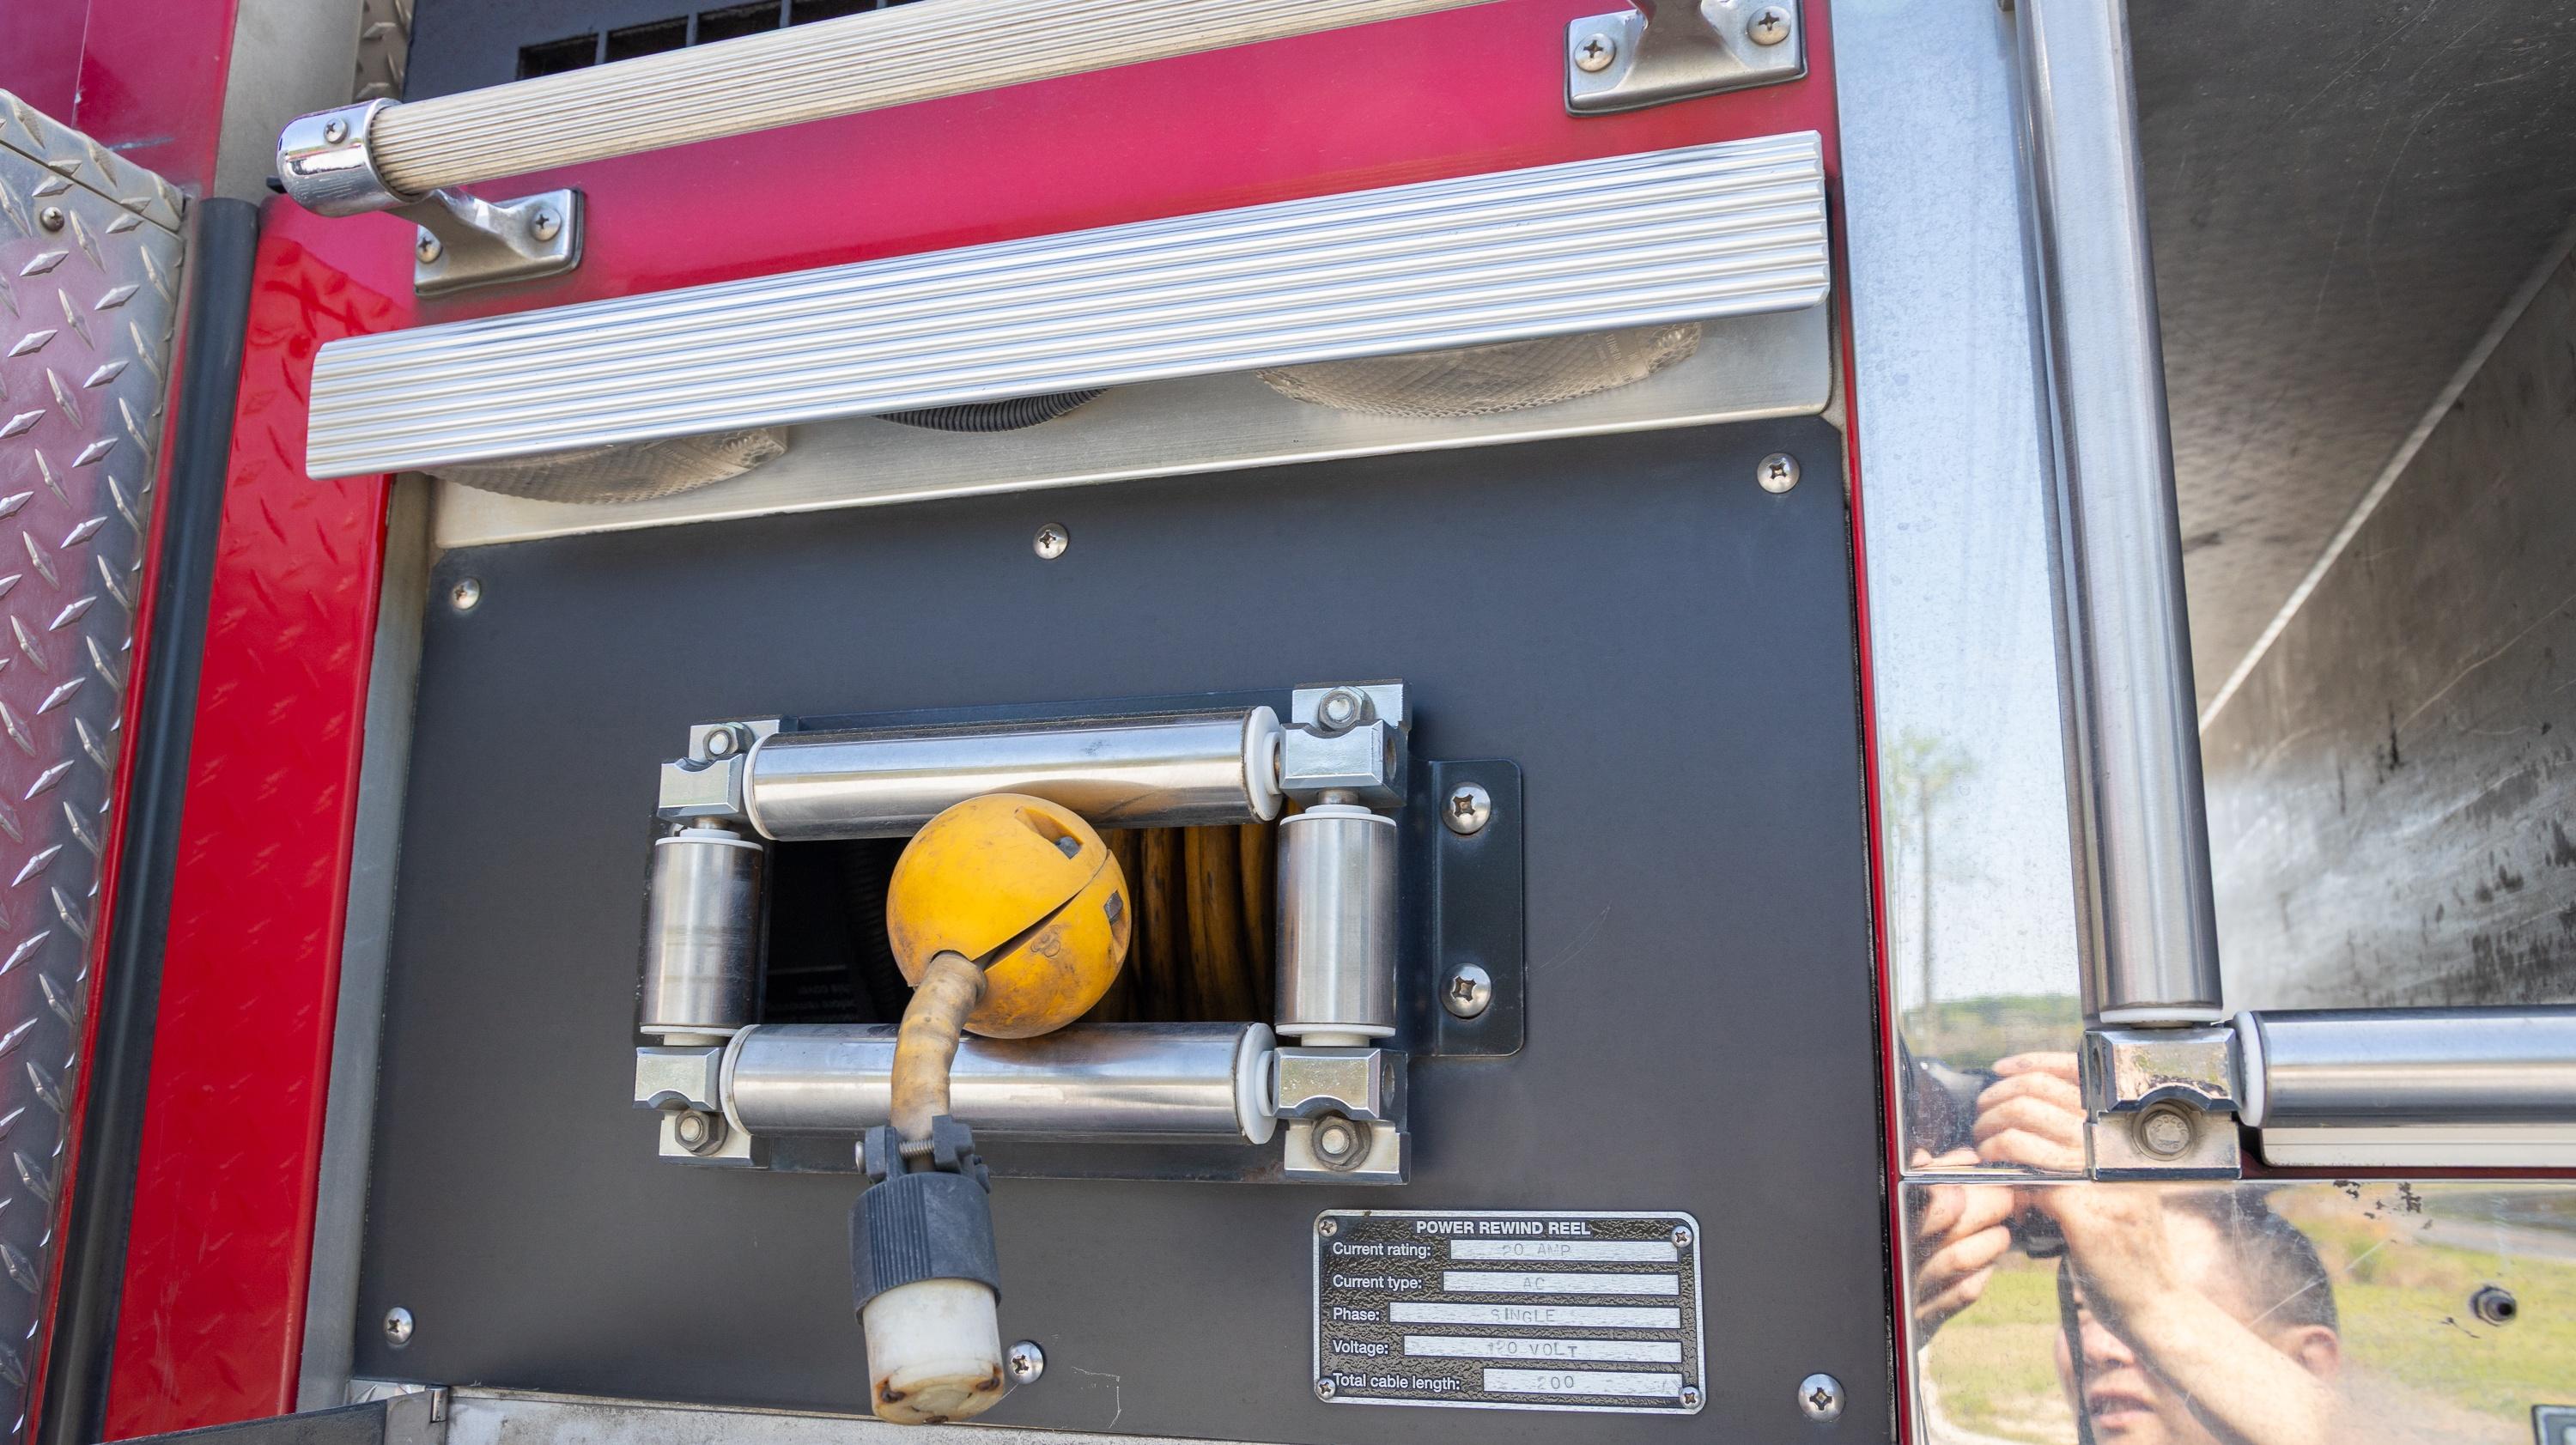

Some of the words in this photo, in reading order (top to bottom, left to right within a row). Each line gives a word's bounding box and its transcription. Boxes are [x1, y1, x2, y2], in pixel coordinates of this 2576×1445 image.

[1416, 1220, 1475, 1235] POWER
[1479, 1221, 1544, 1235] REWIND
[1548, 1222, 1591, 1236] REEL
[1332, 1242, 1384, 1256] Current
[1387, 1244, 1432, 1260] rating:
[1537, 1243, 1571, 1256] AMP
[1332, 1274, 1384, 1289] Current
[1387, 1276, 1423, 1291] type:
[1523, 1277, 1545, 1290] AC
[1333, 1307, 1381, 1321] Phase:
[1491, 1307, 1556, 1323] SINGLE
[1332, 1339, 1389, 1357] Voltage:
[1529, 1342, 1578, 1357] VOLT
[1333, 1372, 1366, 1387] Total
[1370, 1374, 1409, 1389] cable
[1412, 1375, 1461, 1393] length:
